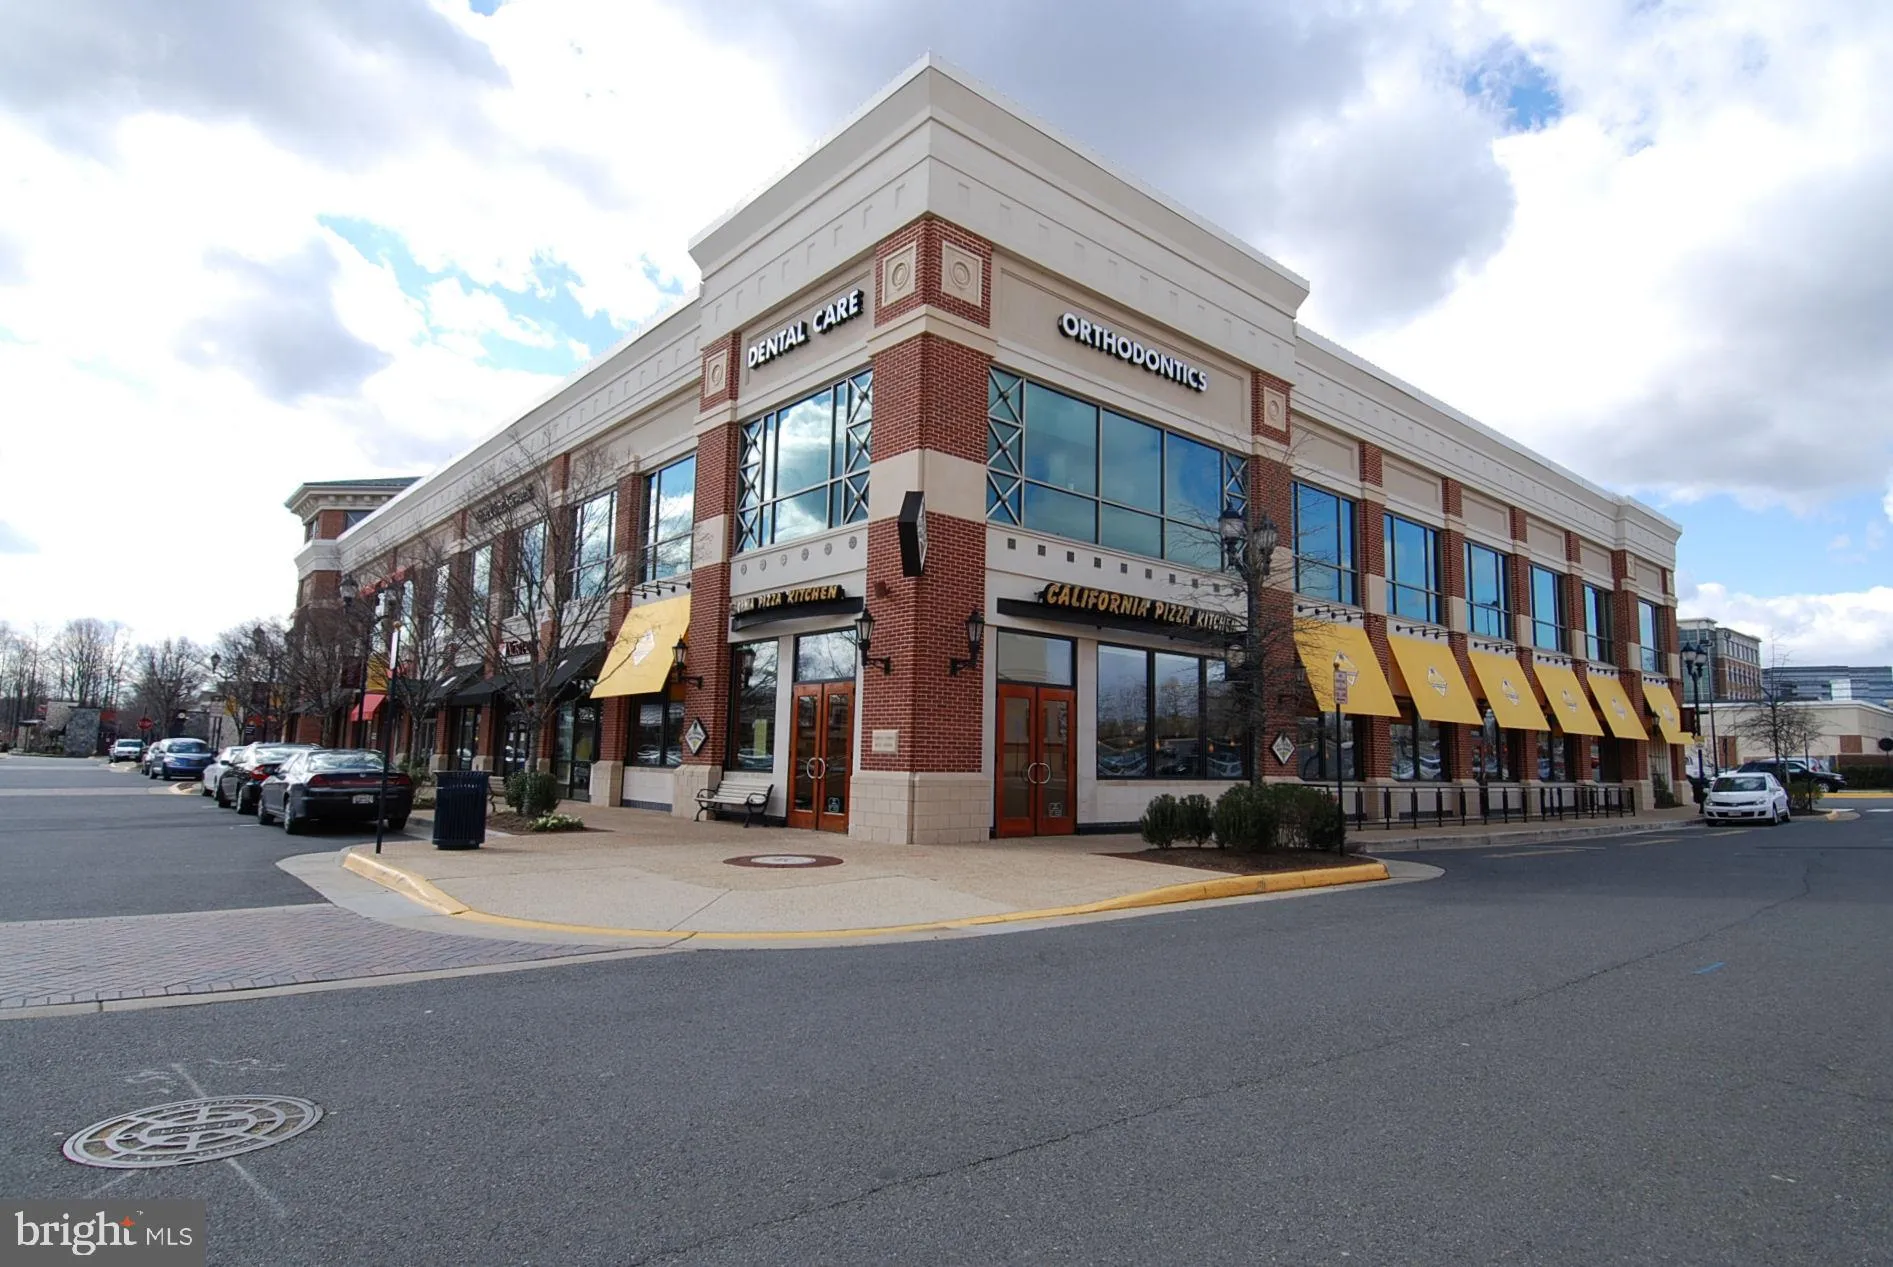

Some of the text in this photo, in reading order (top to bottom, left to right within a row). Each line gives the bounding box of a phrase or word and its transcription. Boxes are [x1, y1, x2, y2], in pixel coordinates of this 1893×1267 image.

[747, 288, 863, 369] DENTAL CARE
[1059, 310, 1208, 393] ORTHODONTICS
[757, 591, 782, 609] PIZZA
[786, 584, 838, 604] KITCHEN
[1047, 583, 1149, 617] CALIFORNIA
[1154, 601, 1192, 625] PIZZA
